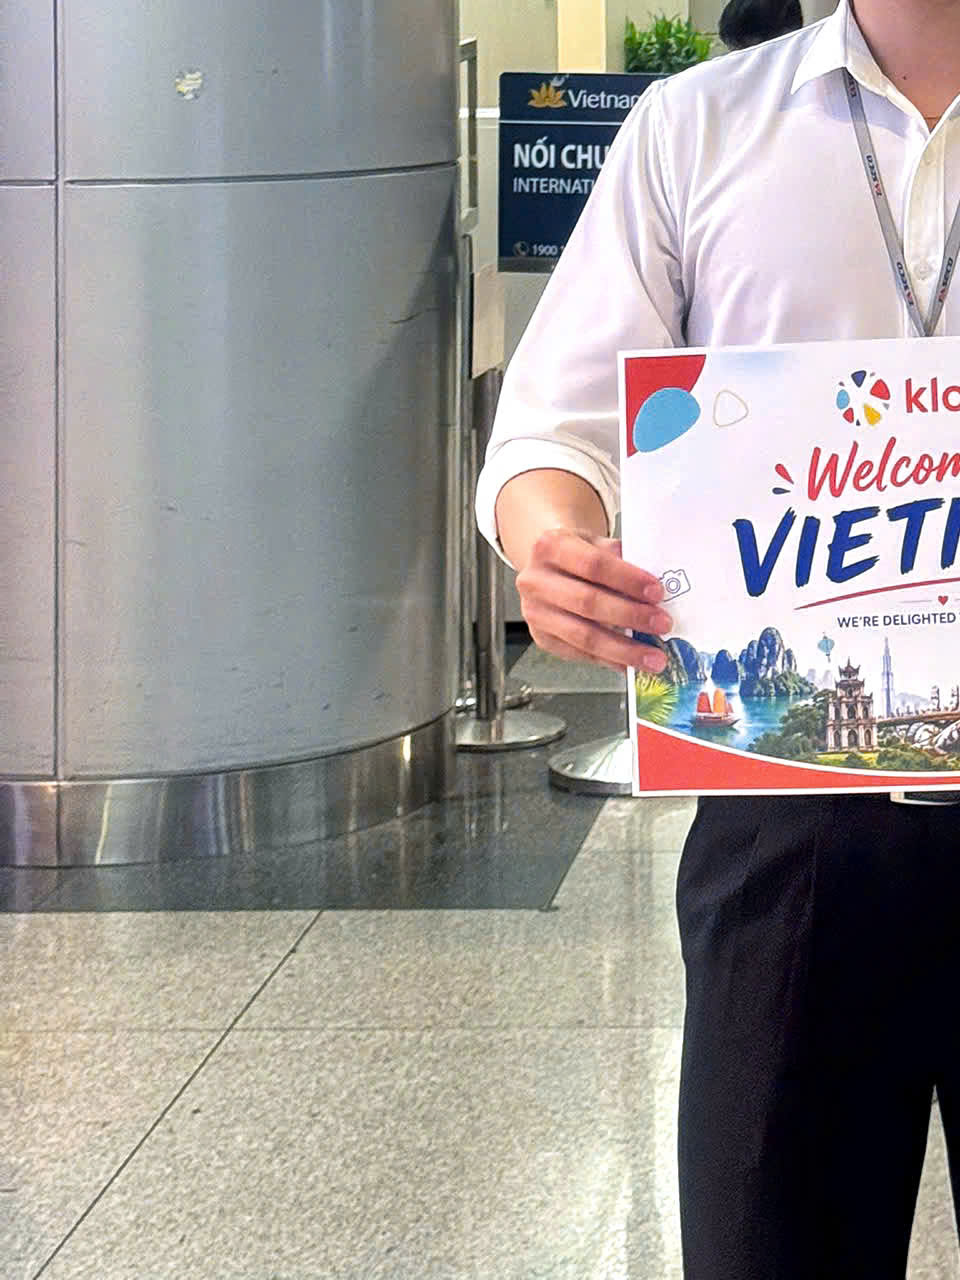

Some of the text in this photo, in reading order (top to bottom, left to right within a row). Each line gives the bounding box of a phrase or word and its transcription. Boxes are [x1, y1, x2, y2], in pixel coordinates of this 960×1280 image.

[513, 136, 555, 169] NỐI
[532, 244, 558, 256] 1900
[838, 615, 879, 628] WE'RE
[883, 611, 956, 626] DELIGHTED
